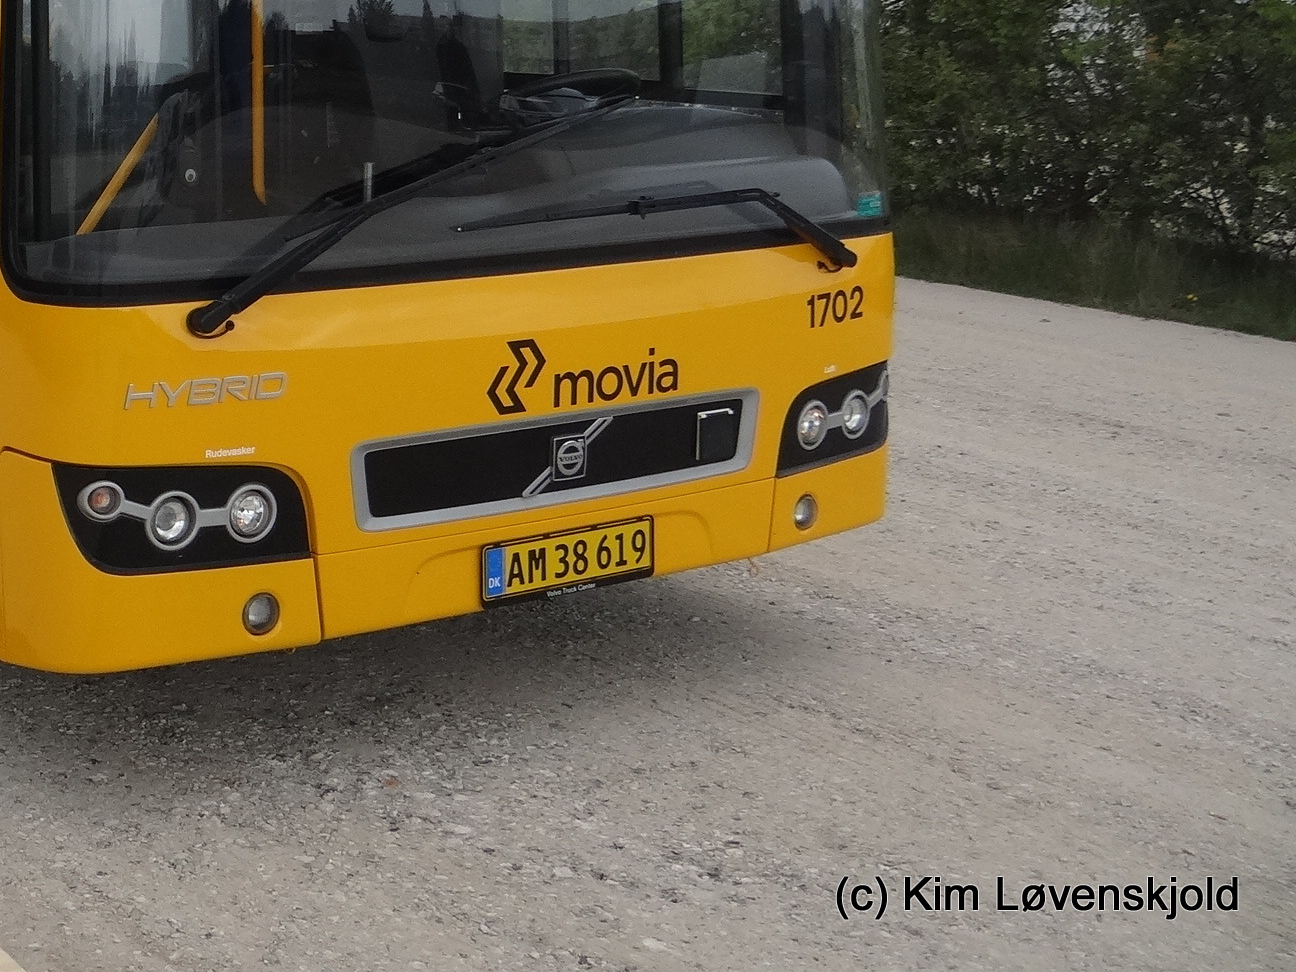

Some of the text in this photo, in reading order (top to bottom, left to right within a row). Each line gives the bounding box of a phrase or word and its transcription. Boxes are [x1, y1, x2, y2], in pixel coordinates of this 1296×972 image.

[806, 285, 864, 329] 1702
[123, 371, 289, 410] HYBRID
[552, 346, 680, 408] movia
[204, 446, 256, 459] Rudevasker
[558, 454, 583, 464] VOLVO
[488, 528, 647, 588] DK AM 38 619
[562, 585, 578, 595] Truck
[578, 582, 596, 593] Center
